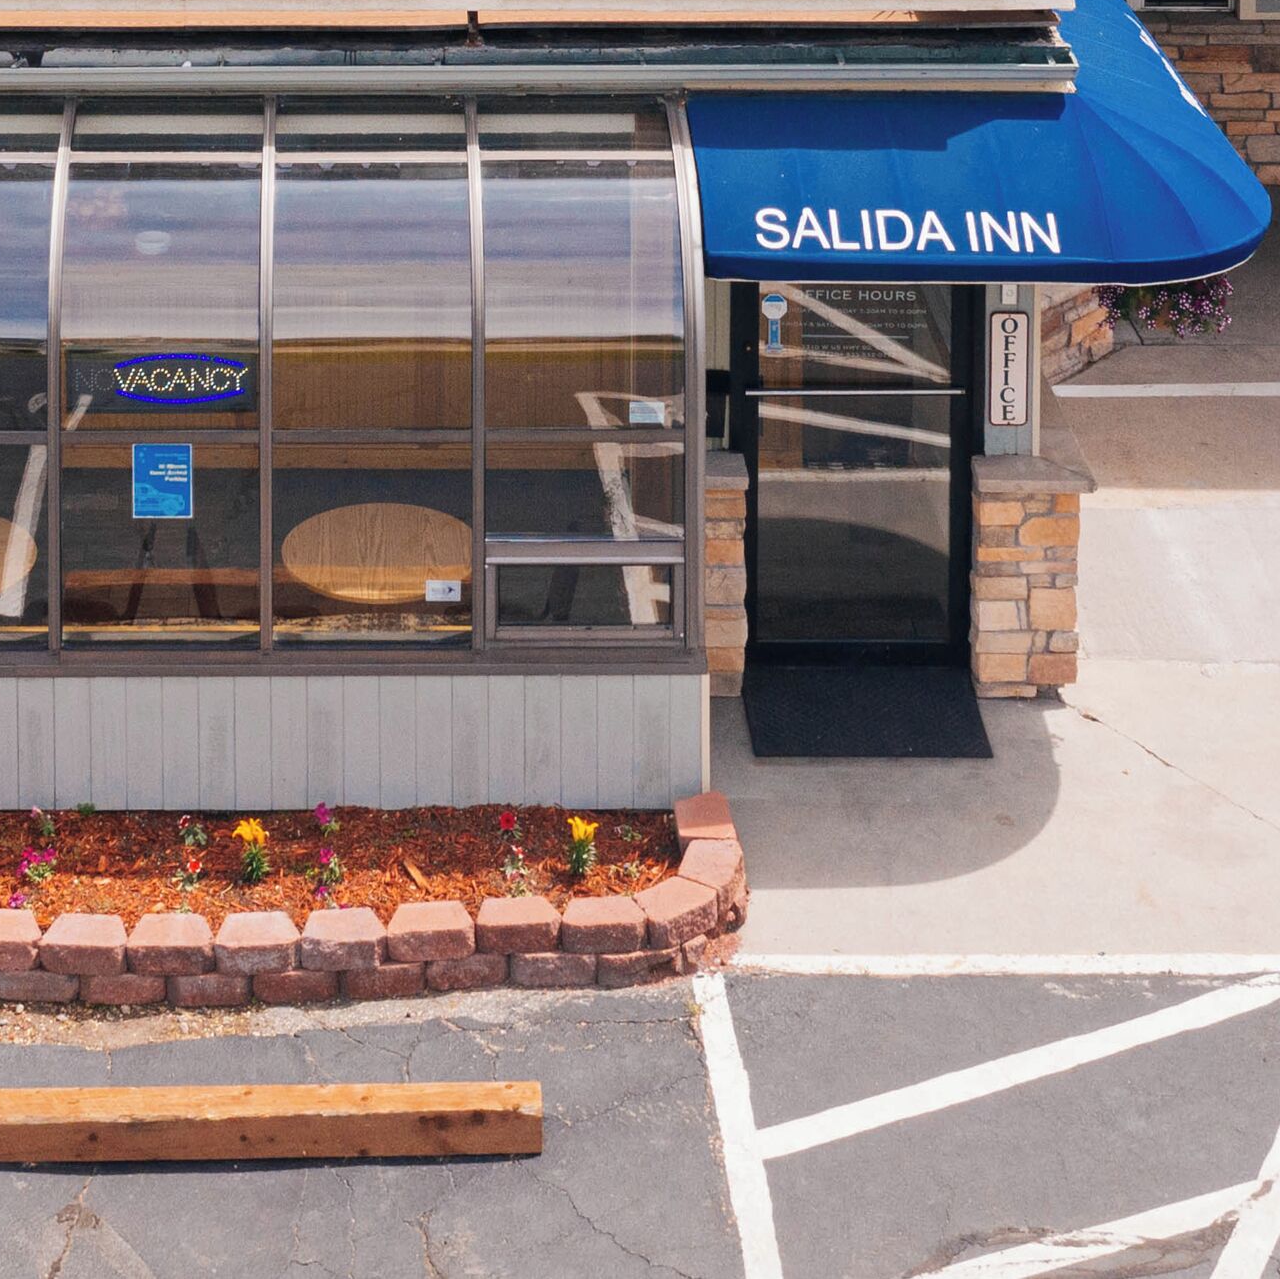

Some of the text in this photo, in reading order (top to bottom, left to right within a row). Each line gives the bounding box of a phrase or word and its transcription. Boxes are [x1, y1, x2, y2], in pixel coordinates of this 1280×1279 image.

[754, 206, 1062, 254] SALIDA INN
[858, 290, 917, 301] HOURS
[111, 366, 247, 392] VACANCY
[999, 317, 1019, 421] OFFICE
